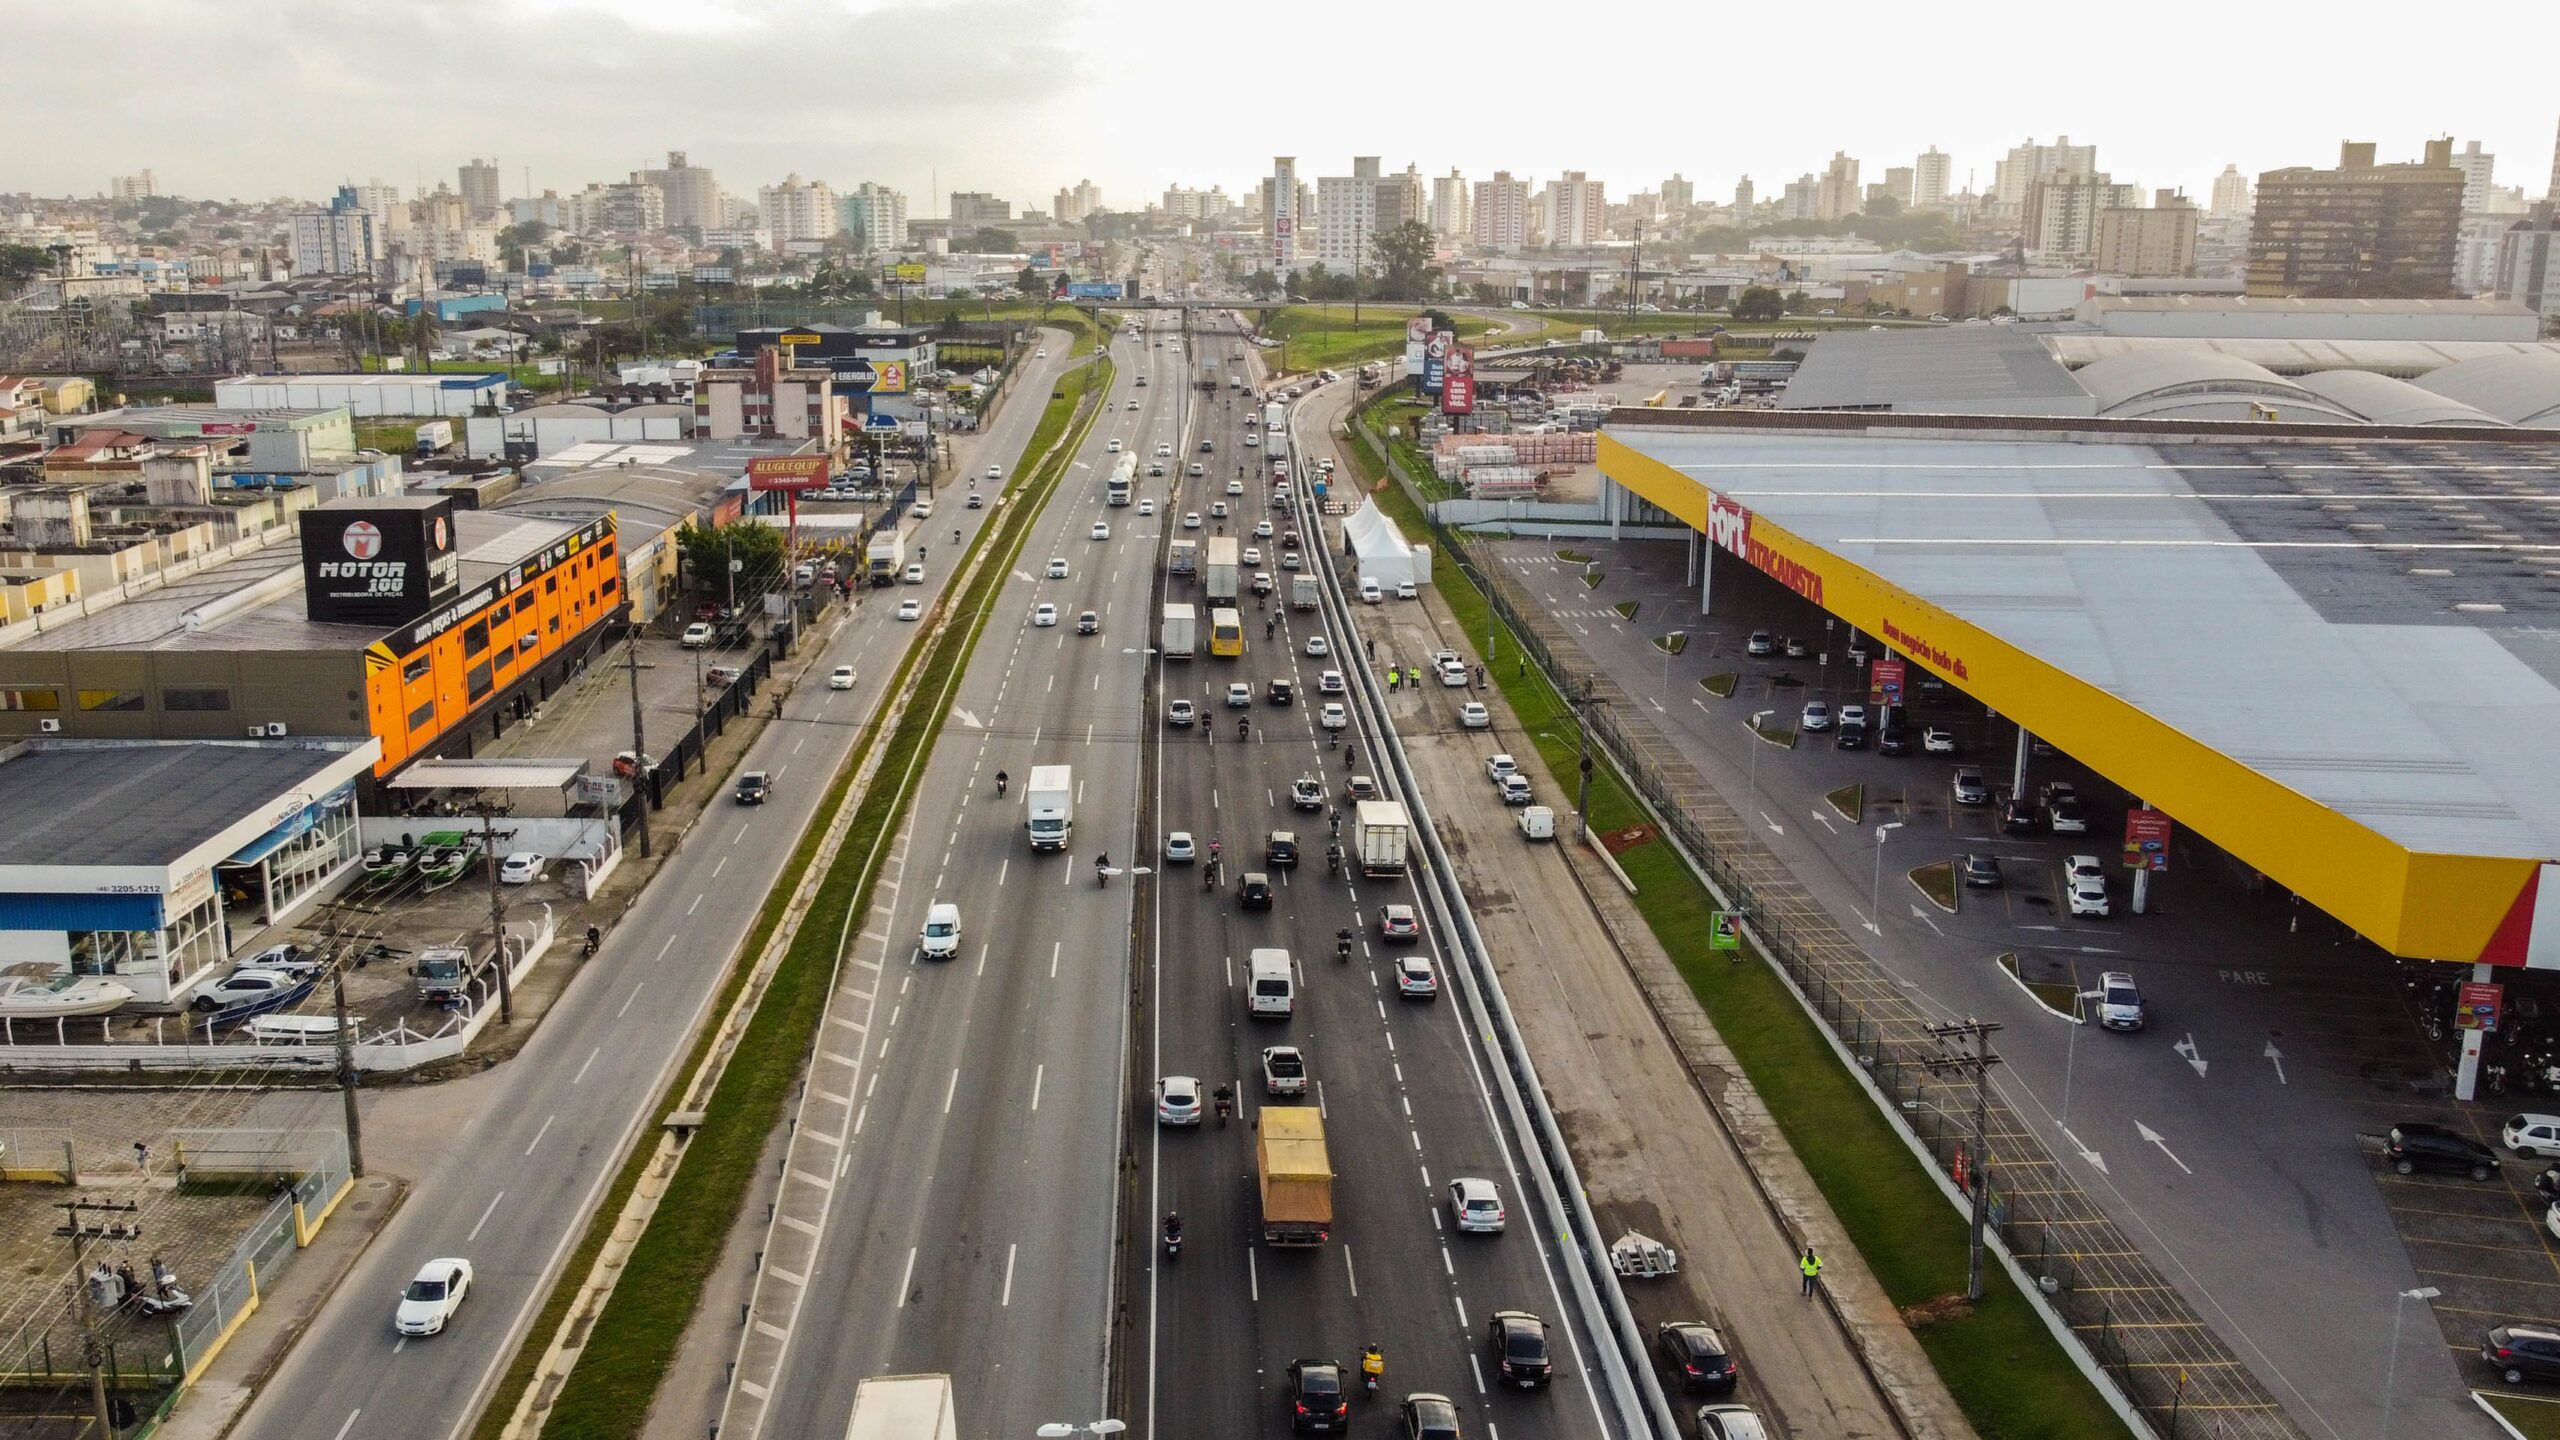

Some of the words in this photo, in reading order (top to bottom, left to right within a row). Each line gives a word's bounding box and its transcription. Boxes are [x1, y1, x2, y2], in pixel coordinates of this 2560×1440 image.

[887, 366, 897, 377] 2
[755, 461, 820, 472] ALUGUEQUIP
[1707, 489, 1747, 559] Fort
[319, 562, 407, 578] MOTOR
[1746, 538, 1824, 608] ATACADISTA
[368, 578, 404, 592] 100
[414, 622, 432, 643] AUTO
[432, 611, 451, 633] PEÇAS
[1883, 617, 1900, 642] Bom
[111, 885, 160, 893] 3205-1212
[2219, 970, 2272, 986] PARE
